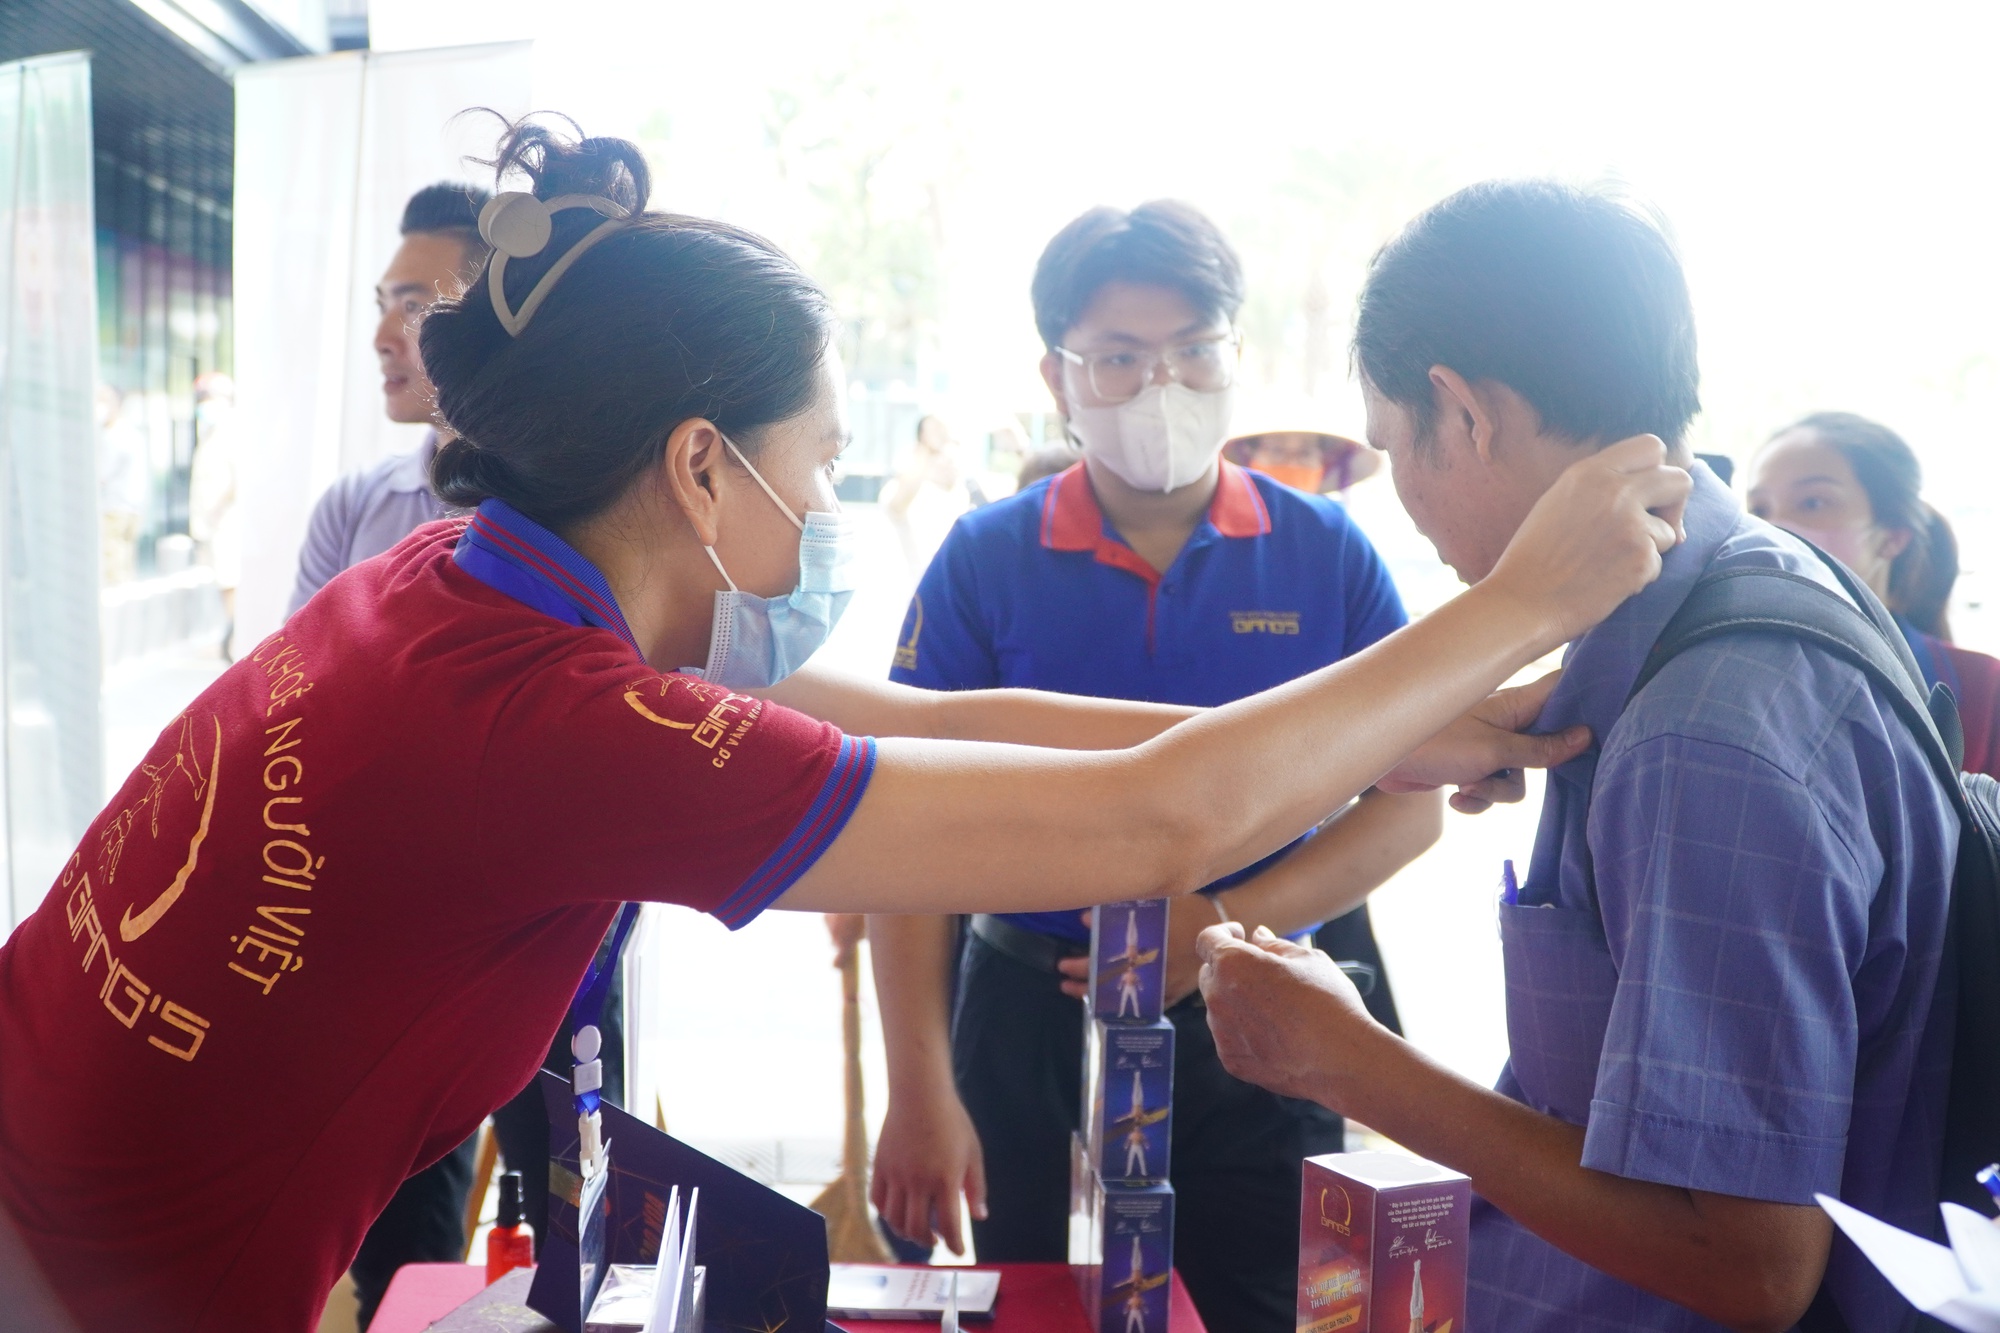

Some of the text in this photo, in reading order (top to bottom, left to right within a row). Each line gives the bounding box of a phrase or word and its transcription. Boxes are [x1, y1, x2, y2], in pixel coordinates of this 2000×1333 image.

[261, 643, 314, 717] KHỎE
[712, 747, 731, 768] CƠ
[726, 718, 753, 746] VÀNG
[262, 717, 325, 891] NGƯỜI
[66, 871, 210, 1062] GIANG'S
[228, 904, 312, 996] VIỆT
